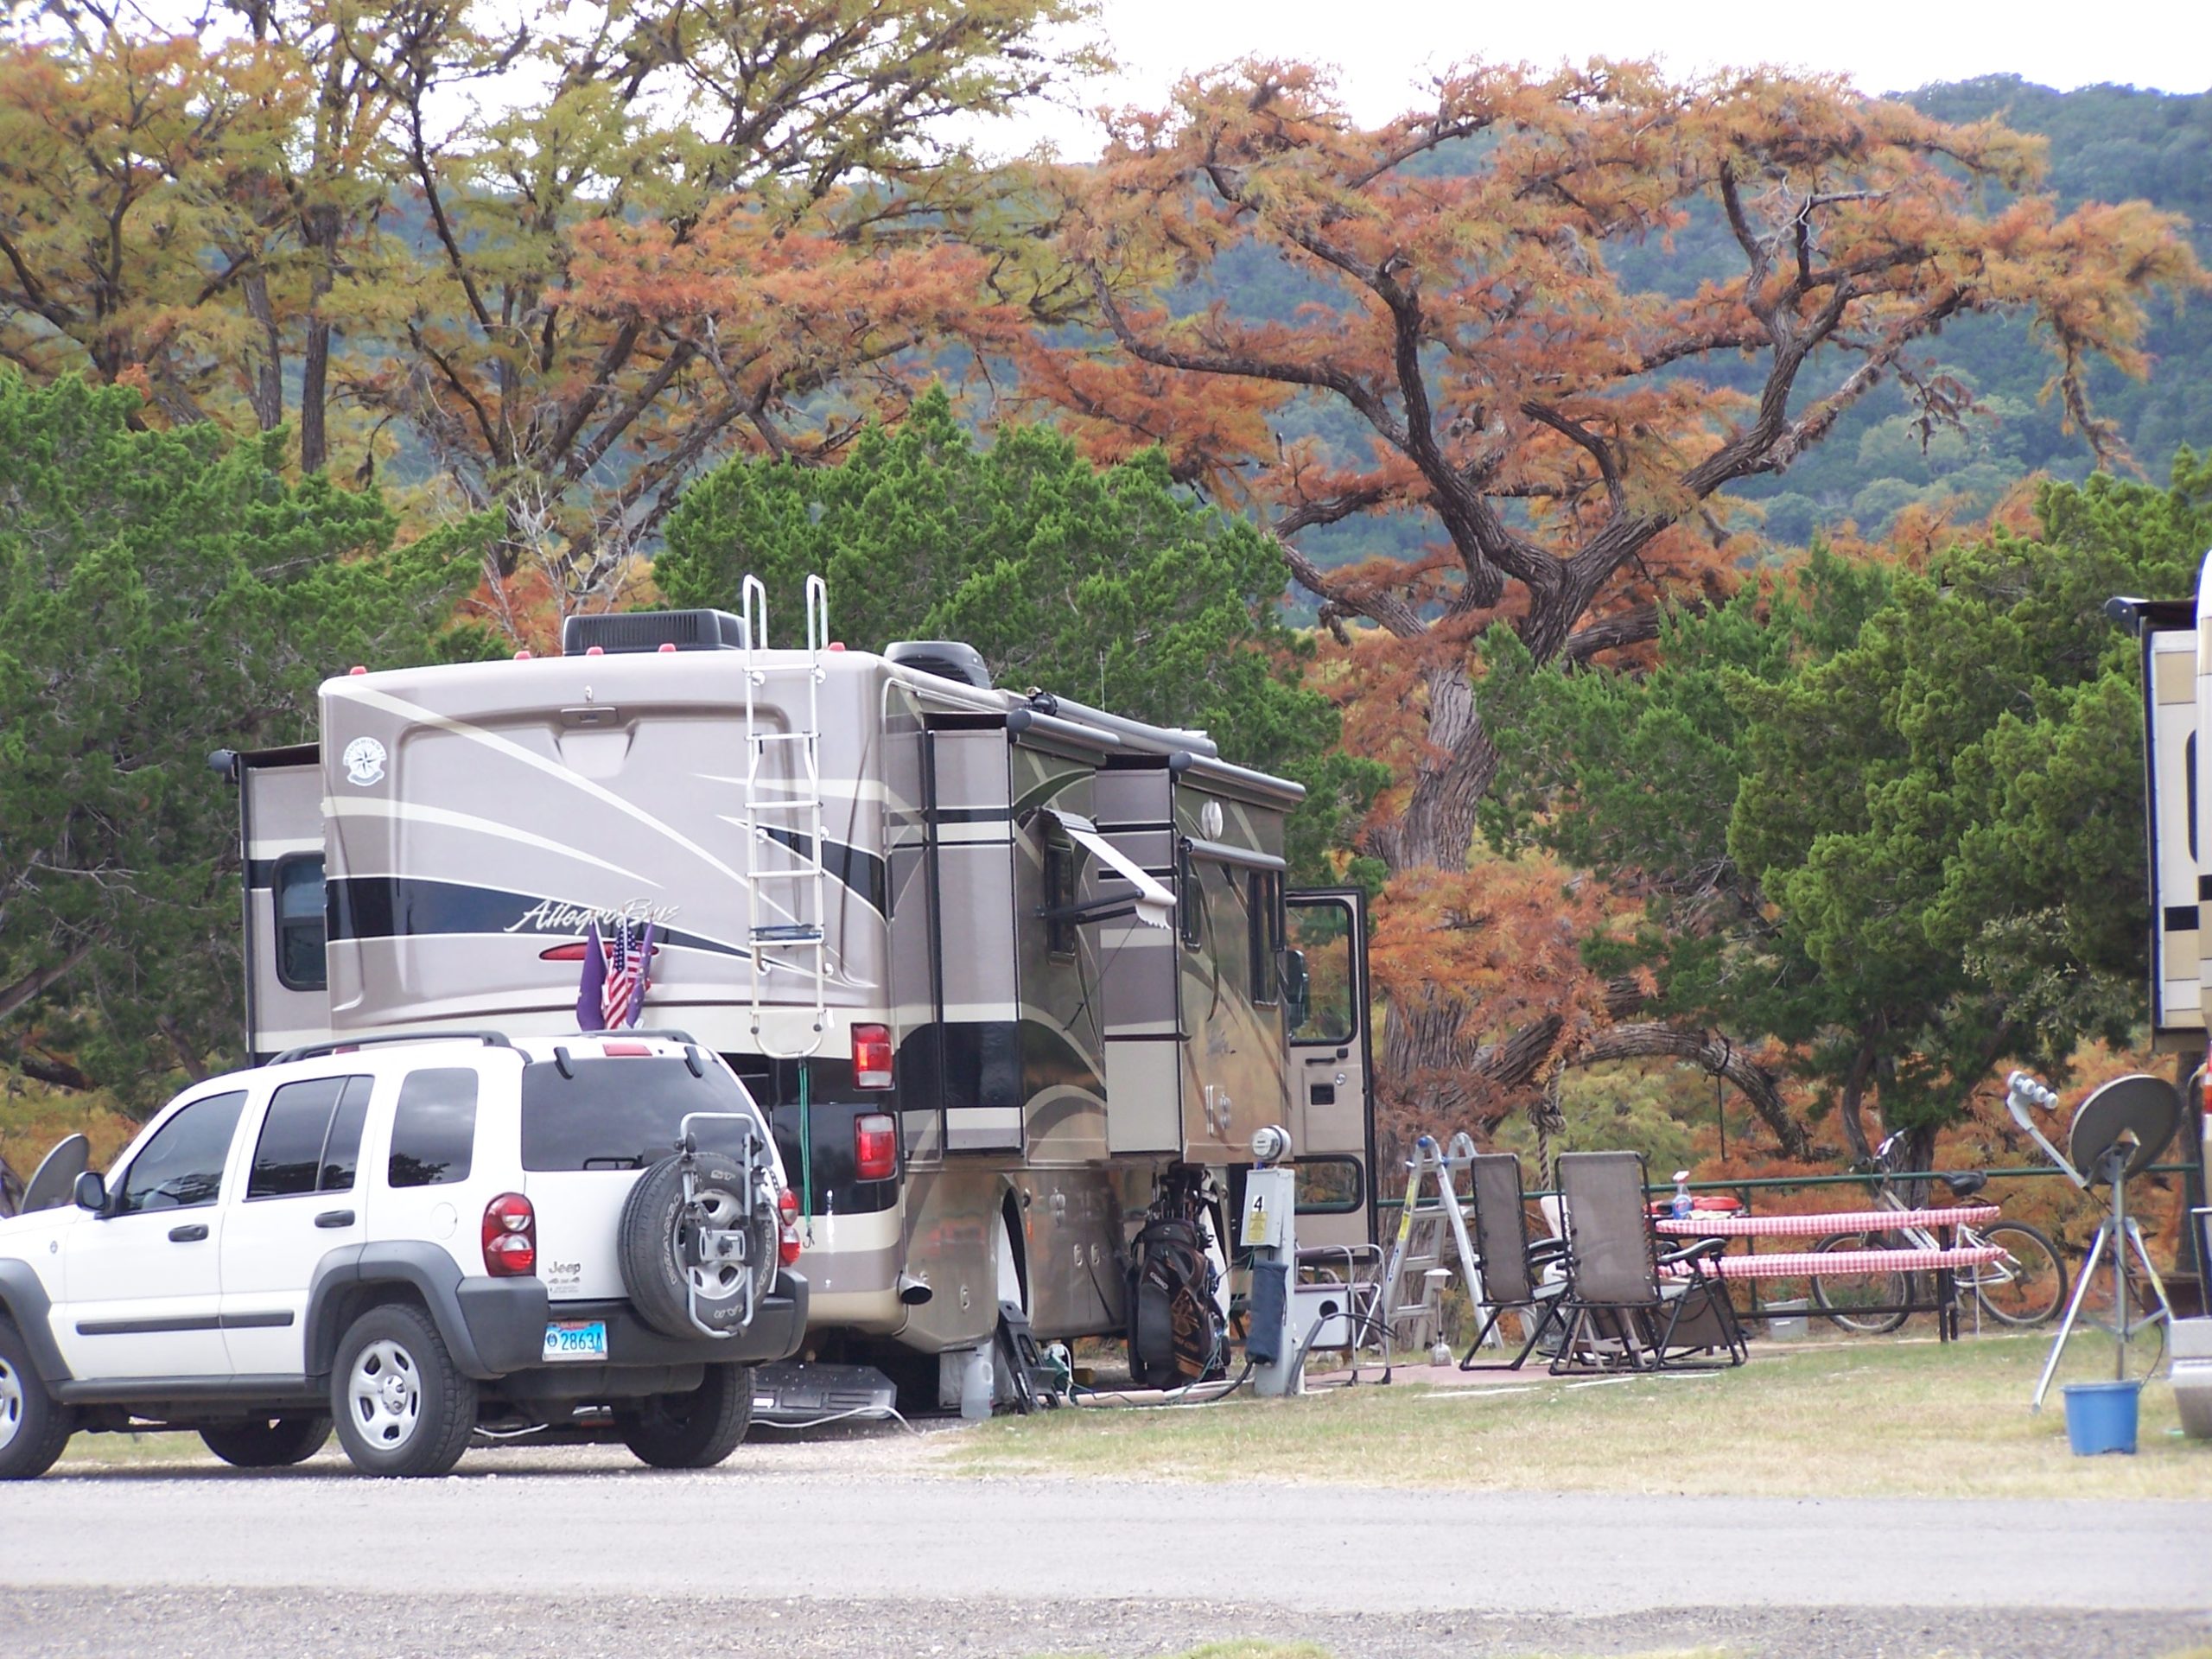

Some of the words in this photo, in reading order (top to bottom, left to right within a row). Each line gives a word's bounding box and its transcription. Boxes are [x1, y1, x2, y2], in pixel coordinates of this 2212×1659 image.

[503, 899, 620, 936] Allegro
[616, 898, 680, 929] Bus
[1254, 1195, 1263, 1212] 4
[548, 1261, 581, 1275] Jeep
